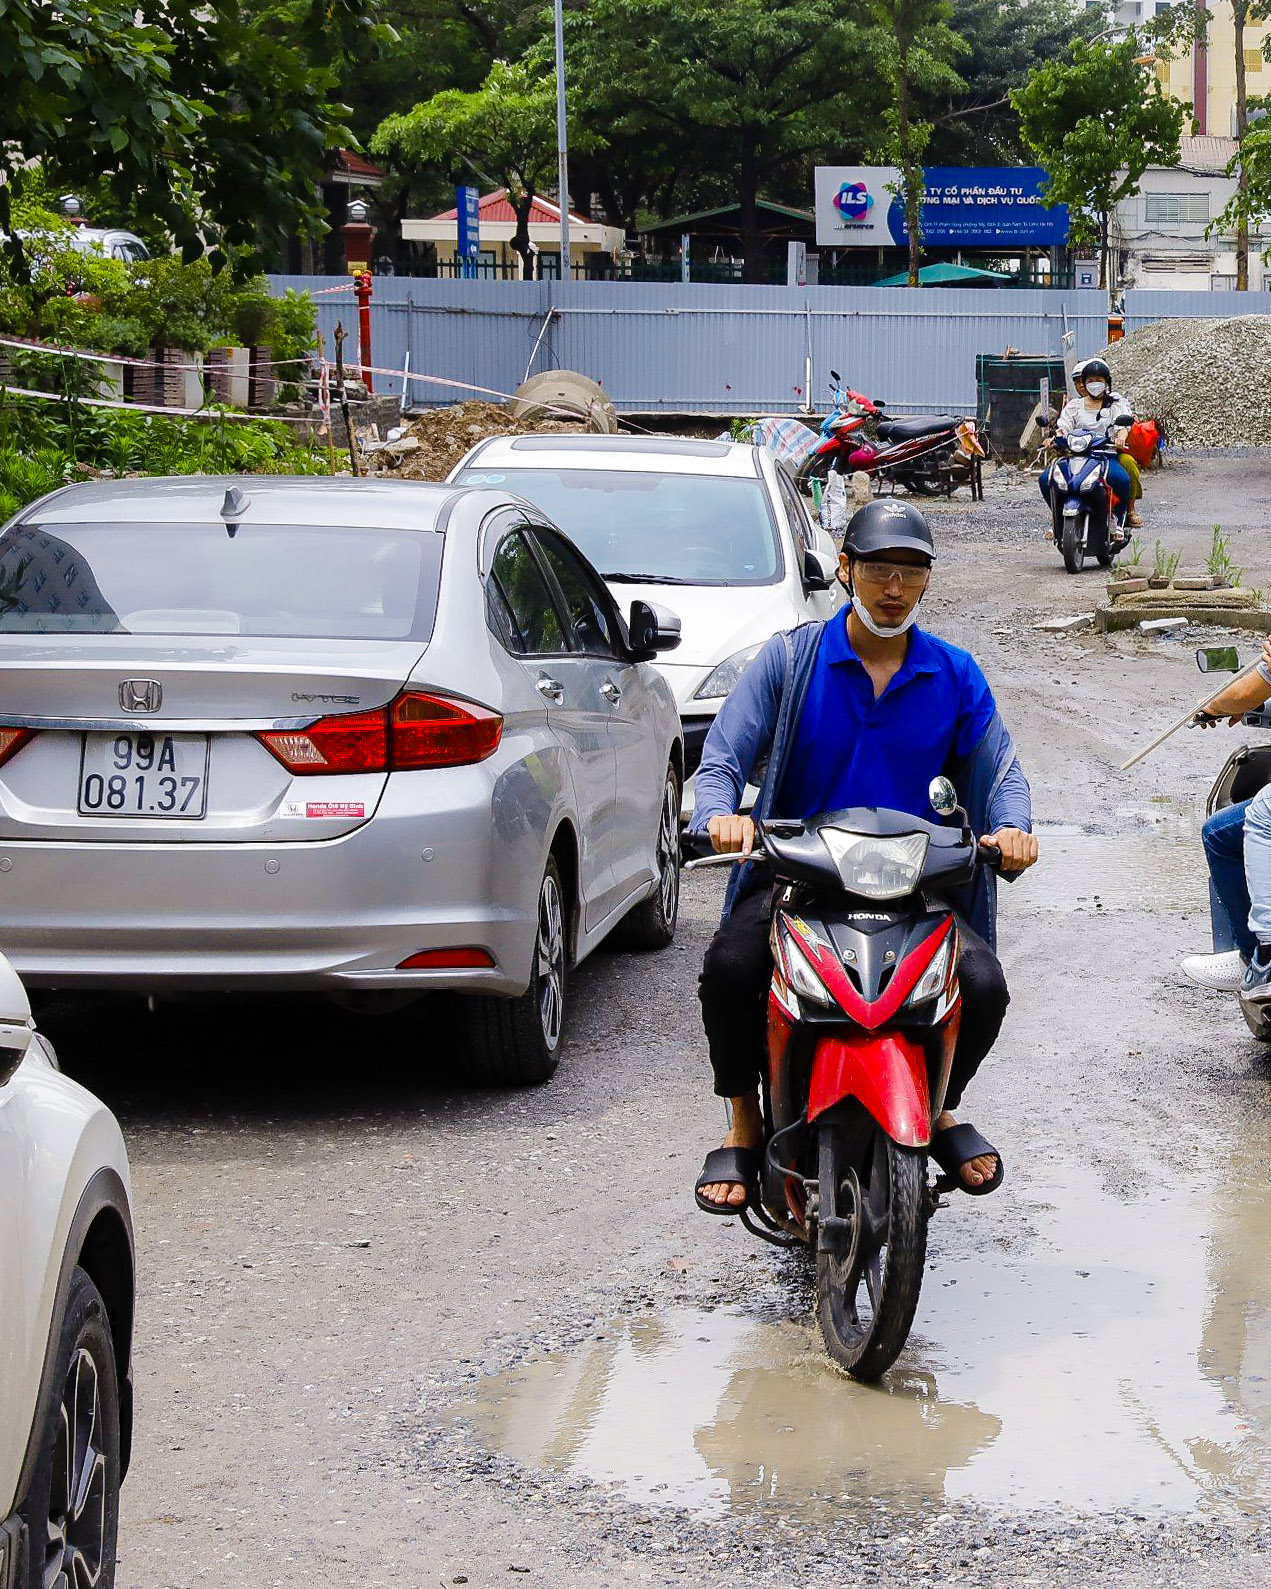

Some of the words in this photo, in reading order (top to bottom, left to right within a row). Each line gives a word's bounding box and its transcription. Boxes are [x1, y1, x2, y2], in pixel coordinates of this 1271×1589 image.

[930, 187, 942, 195] TY
[841, 192, 868, 205] ILS
[943, 196, 960, 206] MẠI
[963, 195, 975, 204] VÀ
[977, 196, 997, 206] DỊCH
[1001, 196, 1014, 206] VỤ
[113, 735, 176, 773] 99A
[84, 773, 201, 812] 081.37
[847, 914, 892, 922] HONDA
